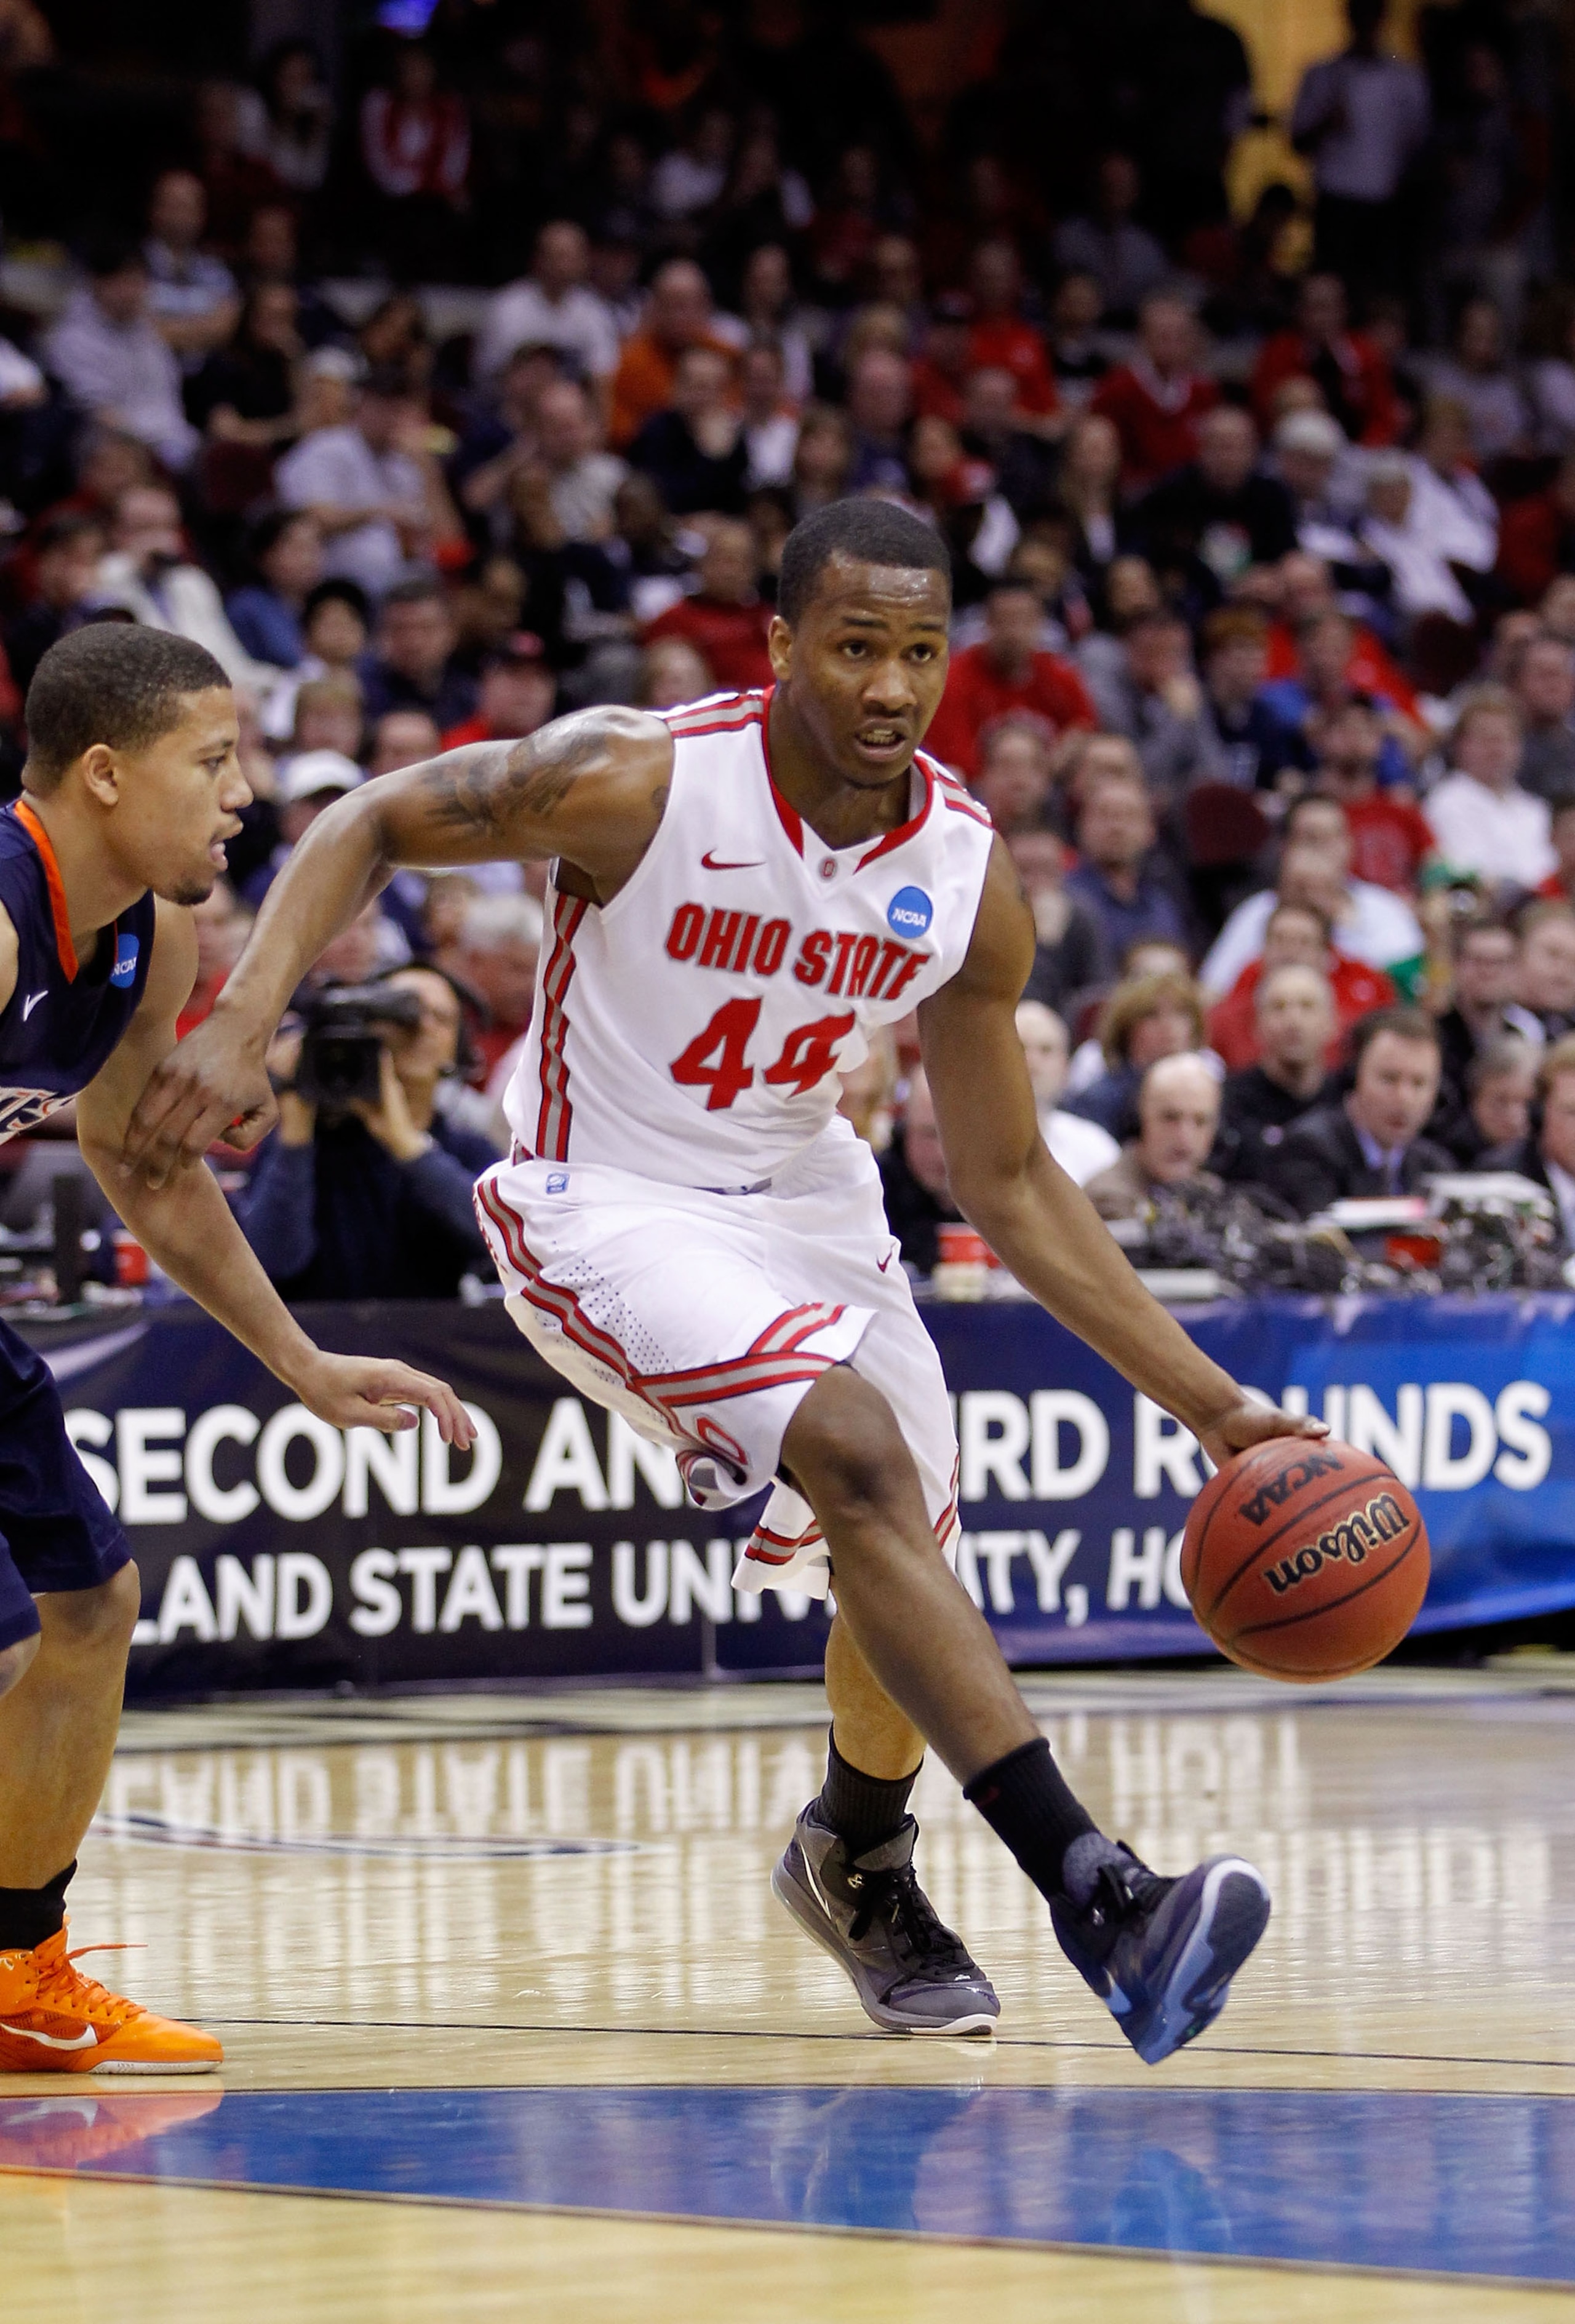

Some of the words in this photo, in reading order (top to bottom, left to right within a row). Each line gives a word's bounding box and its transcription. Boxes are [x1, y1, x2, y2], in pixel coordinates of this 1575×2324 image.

[665, 902, 792, 976] OHIO
[792, 928, 934, 1001] STATE
[891, 907, 927, 928] NCAA
[670, 996, 856, 1111] 44
[64, 1402, 503, 1525] SECOND
[522, 1395, 698, 1513] AN
[1239, 1449, 1345, 1526] NCAA
[348, 1540, 594, 1638] STATE
[1264, 1493, 1410, 1594] Wilson
